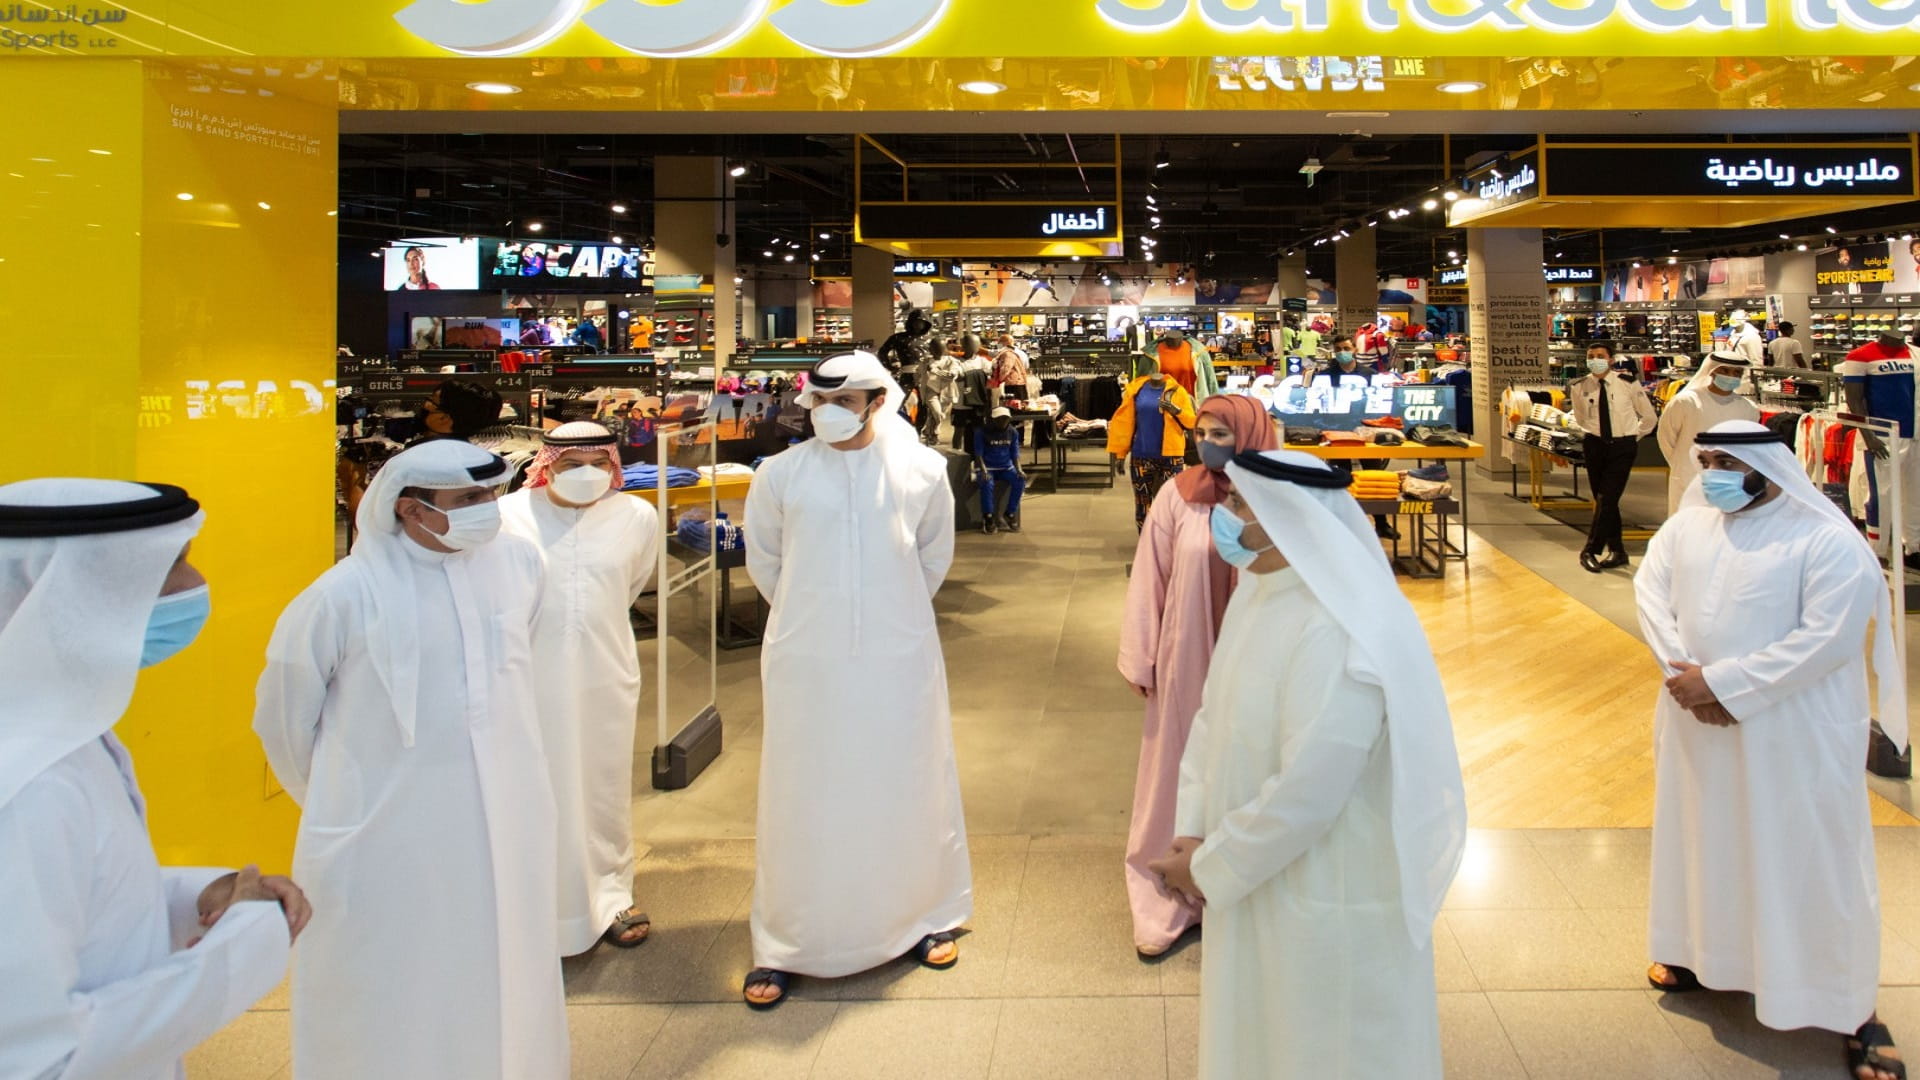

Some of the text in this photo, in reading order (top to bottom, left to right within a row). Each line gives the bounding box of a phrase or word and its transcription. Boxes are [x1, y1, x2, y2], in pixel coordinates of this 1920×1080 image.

[1, 29, 79, 51] Sports
[171, 118, 193, 131] SUN
[196, 124, 202, 132] &
[206, 126, 231, 138] SAND
[233, 131, 269, 145] SPORTS
[1706, 158, 1900, 187] ملابس رياضية
[1505, 164, 1535, 197] ملابس
[1042, 208, 1105, 235] أطفال
[492, 242, 641, 279] ESCAPE
[893, 262, 935, 275] كرة الس
[1569, 268, 1593, 279] نمط
[1817, 268, 1895, 285] SPORTSWEAR
[1490, 300, 1528, 308] promise
[1510, 321, 1542, 329] latest
[1491, 345, 1540, 354] best for
[1492, 356, 1543, 368] Dubai,
[1878, 361, 1914, 372] elles
[369, 381, 403, 390] GIRLS
[495, 378, 522, 386] 4-14
[1222, 374, 1395, 414] ESCAPE
[1404, 389, 1436, 405] THE
[1404, 406, 1443, 421] CITY
[1400, 501, 1434, 514] HIKE
